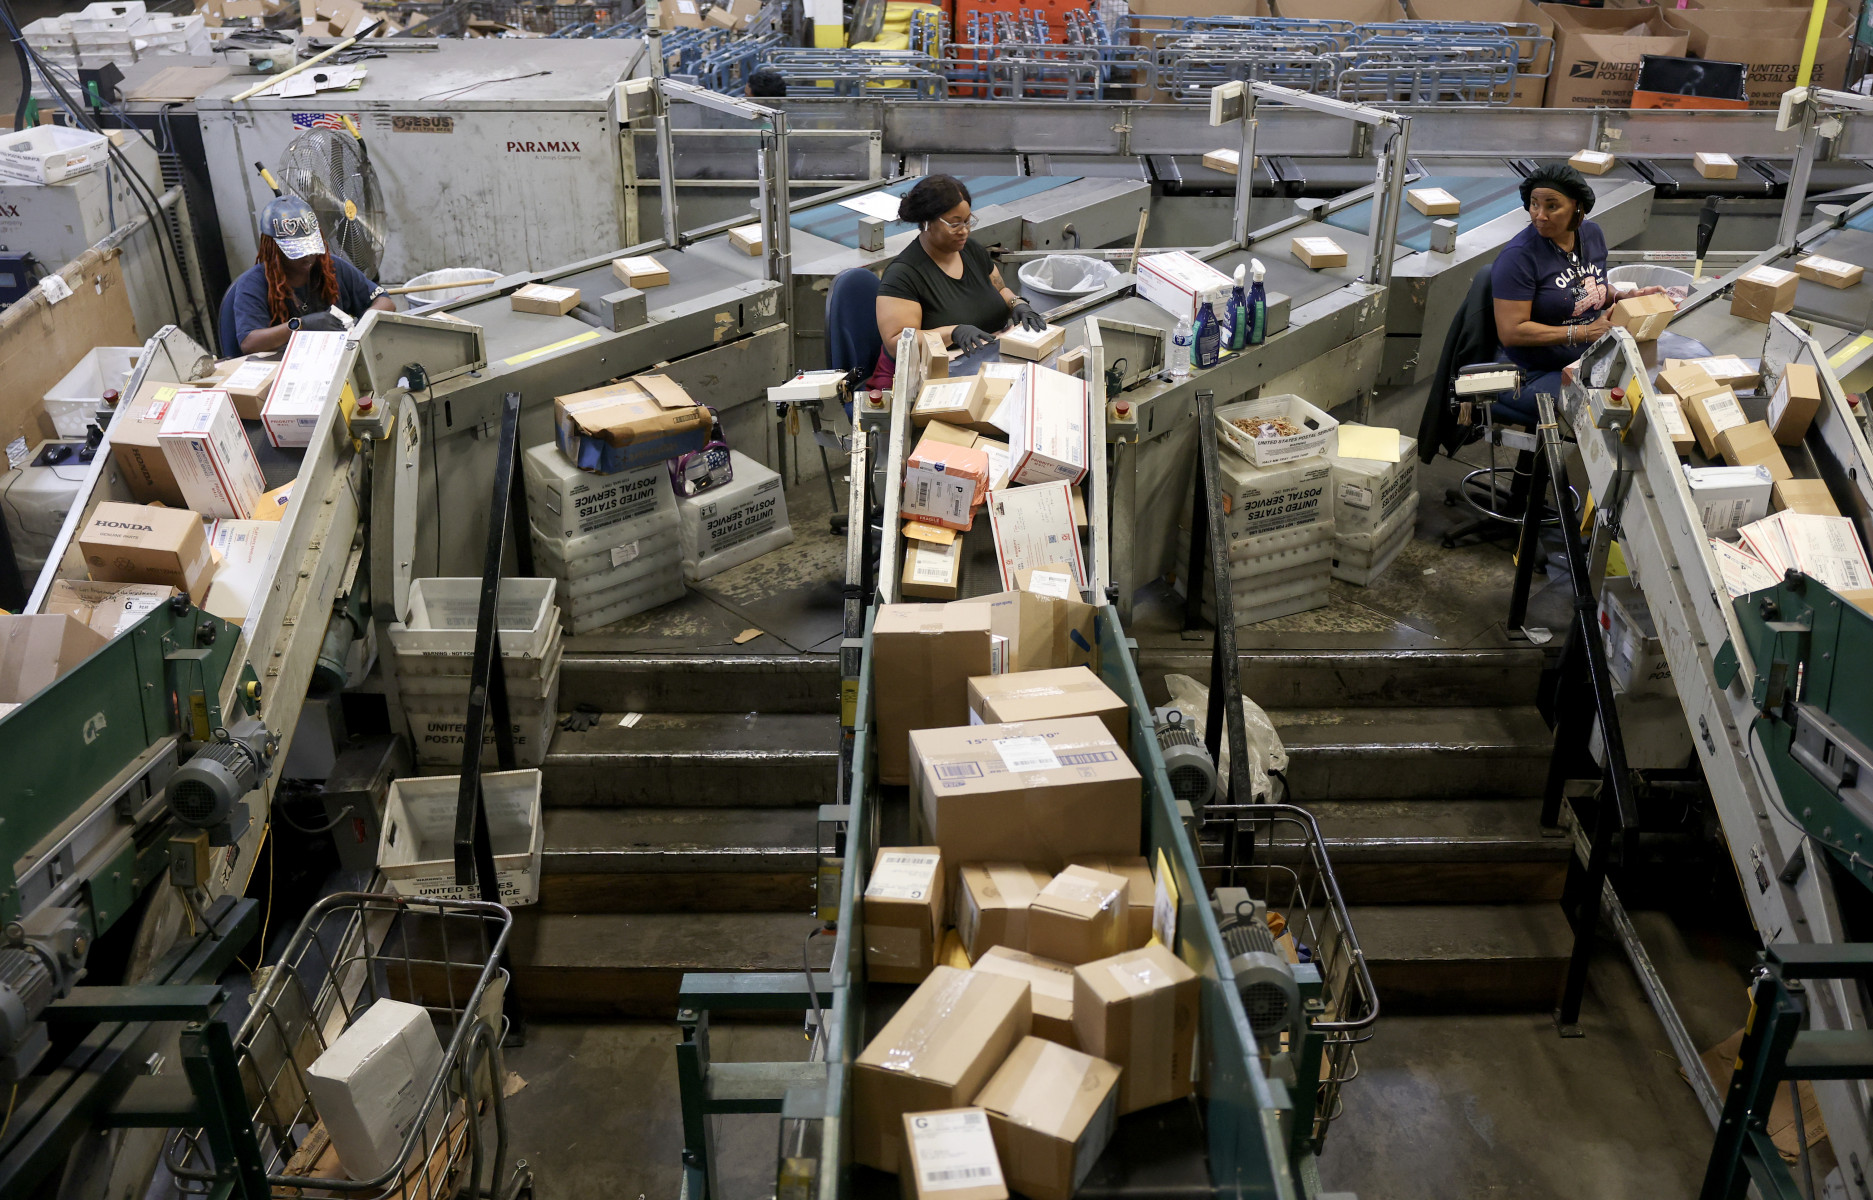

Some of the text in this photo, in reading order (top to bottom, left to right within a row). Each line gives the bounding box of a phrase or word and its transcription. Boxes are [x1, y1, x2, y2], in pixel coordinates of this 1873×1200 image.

[1601, 62, 1639, 71] UNITED
[1752, 64, 1824, 73] UNITED STES
[1596, 72, 1634, 81] POSTAL
[1749, 74, 1783, 83] POSTAL
[406, 116, 450, 127] JESUS
[507, 142, 580, 152] PARAMAX
[1555, 270, 1576, 289] OLD
[132, 447, 154, 486] HONDA
[575, 476, 657, 508] POSTAL SERVICE
[580, 488, 654, 517] UNITED STATES
[1244, 486, 1323, 511] POSTAL SERVICE
[707, 497, 776, 530] POSTAL SERVICE
[1248, 498, 1318, 520] UNITED STATES
[711, 508, 773, 539] UNITED STATES
[919, 515, 940, 524] FRAGILE
[95, 520, 153, 532] HONDA
[125, 601, 133, 610] G
[428, 723, 466, 733] UNITE
[424, 735, 465, 744] POSTA
[419, 881, 513, 895] UNITED STES
[469, 888, 521, 900] SEICE
[915, 1117, 928, 1129] G
